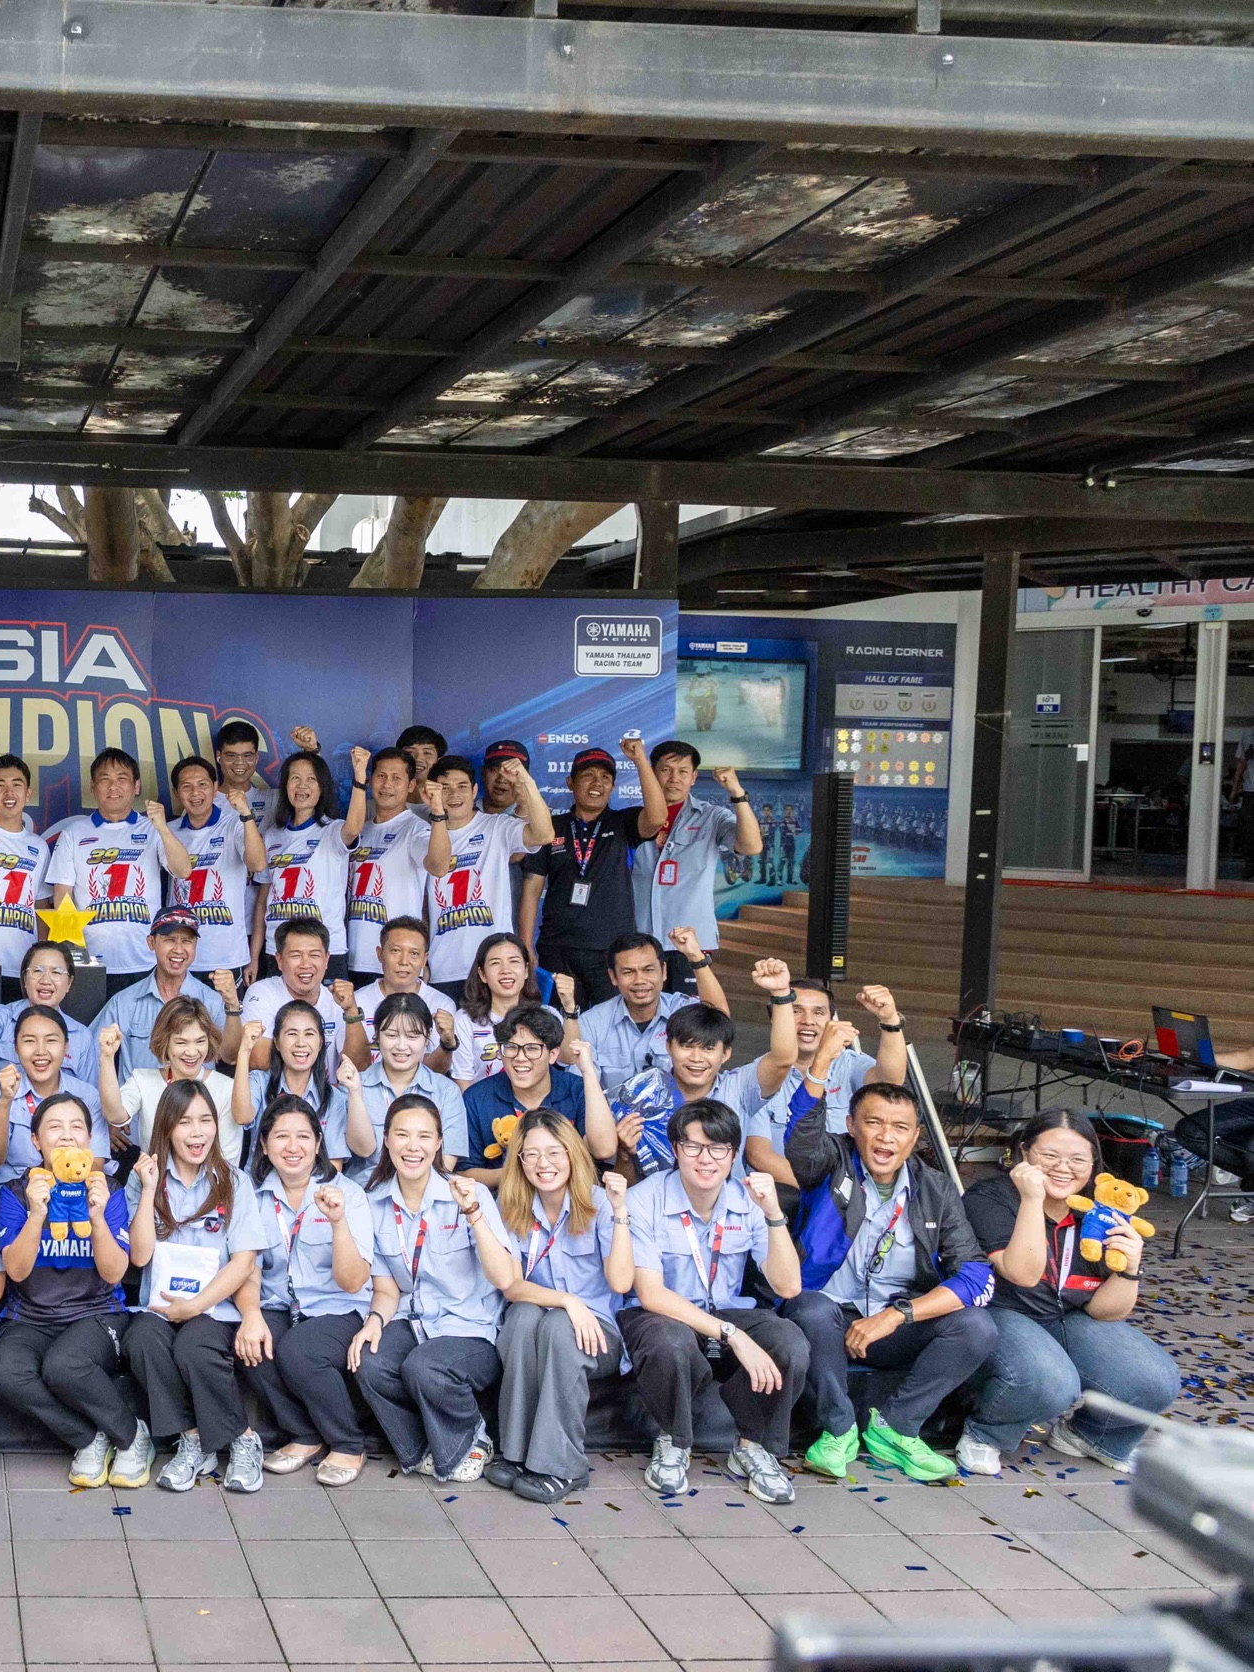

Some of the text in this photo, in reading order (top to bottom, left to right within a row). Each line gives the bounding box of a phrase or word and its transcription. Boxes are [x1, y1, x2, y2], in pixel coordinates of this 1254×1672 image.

[601, 623, 651, 638] YAMAHA
[617, 652, 651, 660] THAILAND
[846, 646, 944, 657] RACING CORNER
[864, 675, 886, 683] HALL
[900, 676, 924, 684] FAME
[547, 734, 589, 744] ENEOS
[87, 847, 120, 865] 39
[3, 870, 29, 905] 1
[103, 863, 131, 903] 1
[184, 869, 209, 907] 1
[279, 866, 302, 902] 1
[355, 862, 375, 899] 1
[447, 869, 471, 907] 1
[90, 896, 147, 905] ASIA AP250
[41, 1239, 94, 1257] YAMAH
